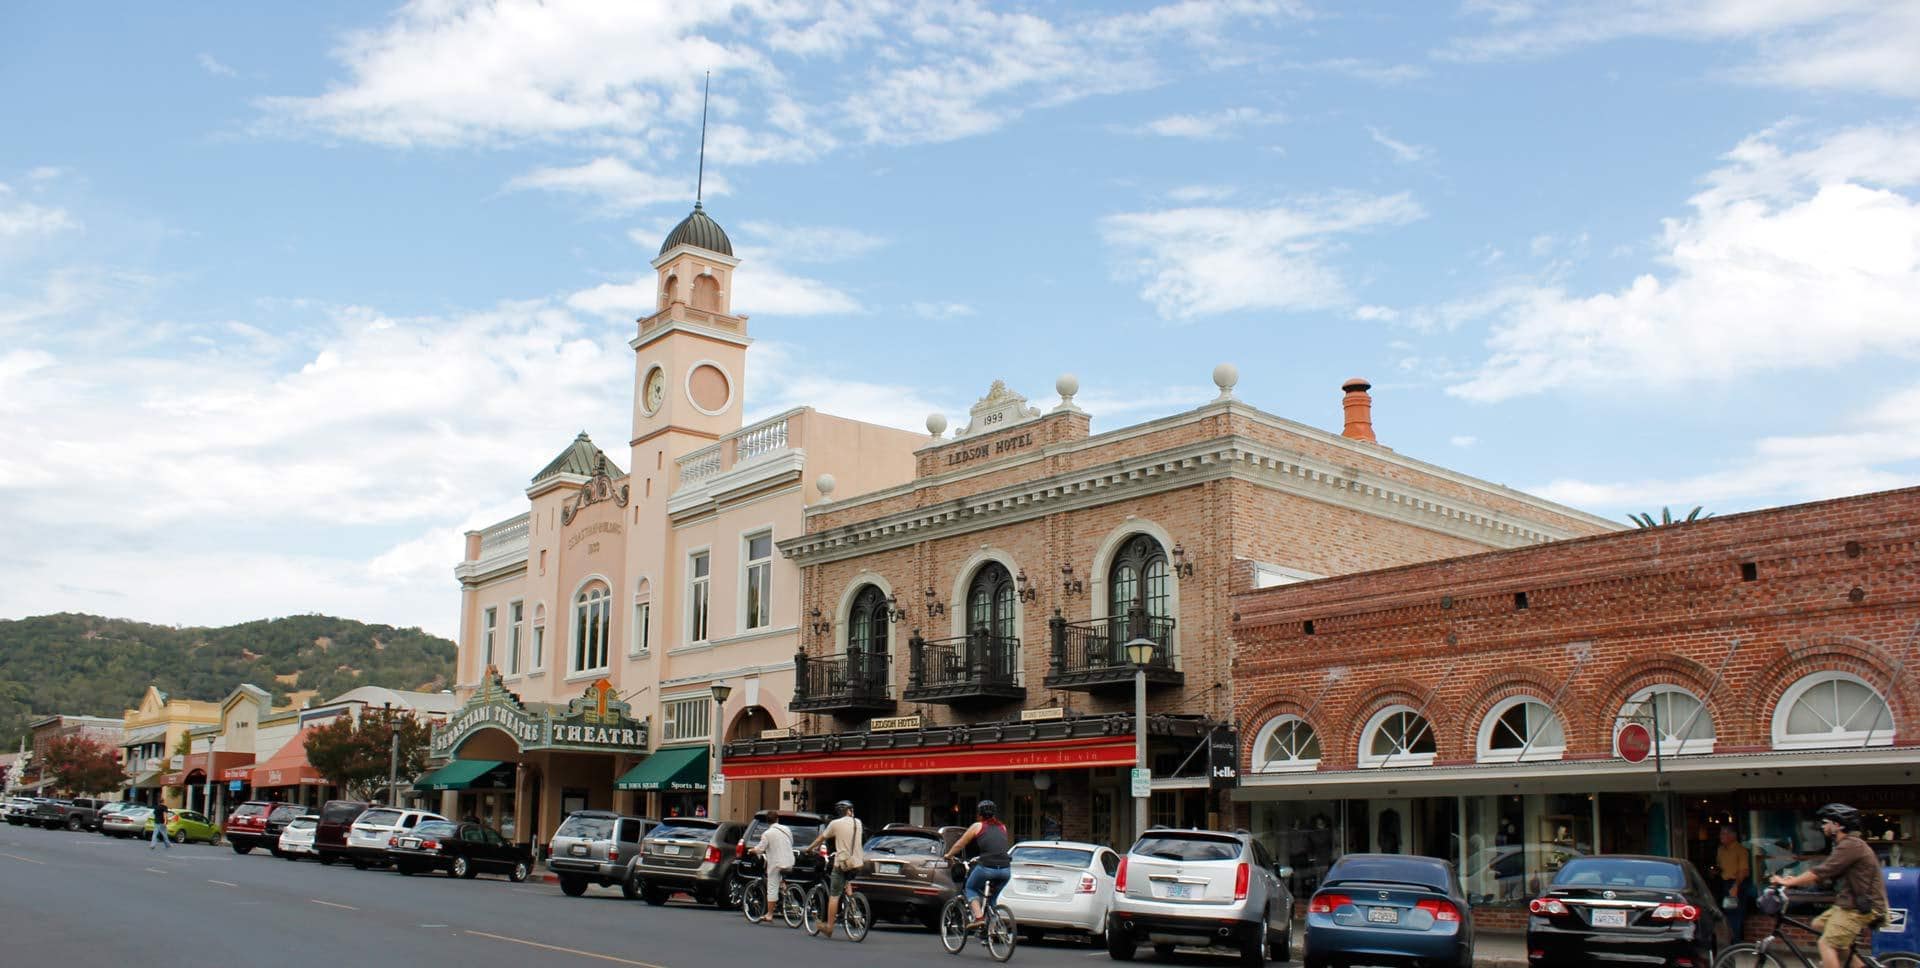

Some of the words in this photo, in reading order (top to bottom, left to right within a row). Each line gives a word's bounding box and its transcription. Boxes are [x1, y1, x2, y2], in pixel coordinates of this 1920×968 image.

[983, 412, 1003, 426] 1999
[948, 444, 989, 466] LEDSON
[995, 433, 1033, 454] HOTEL
[437, 705, 490, 751] SEBASTIANI
[494, 705, 539, 741] THEATRE
[871, 720, 897, 729] LEDSON
[898, 717, 919, 727] HOTEL
[553, 724, 648, 746] THEATRE
[1009, 752, 1048, 764] centre
[1078, 751, 1097, 761] vin
[671, 781, 692, 790] Sports
